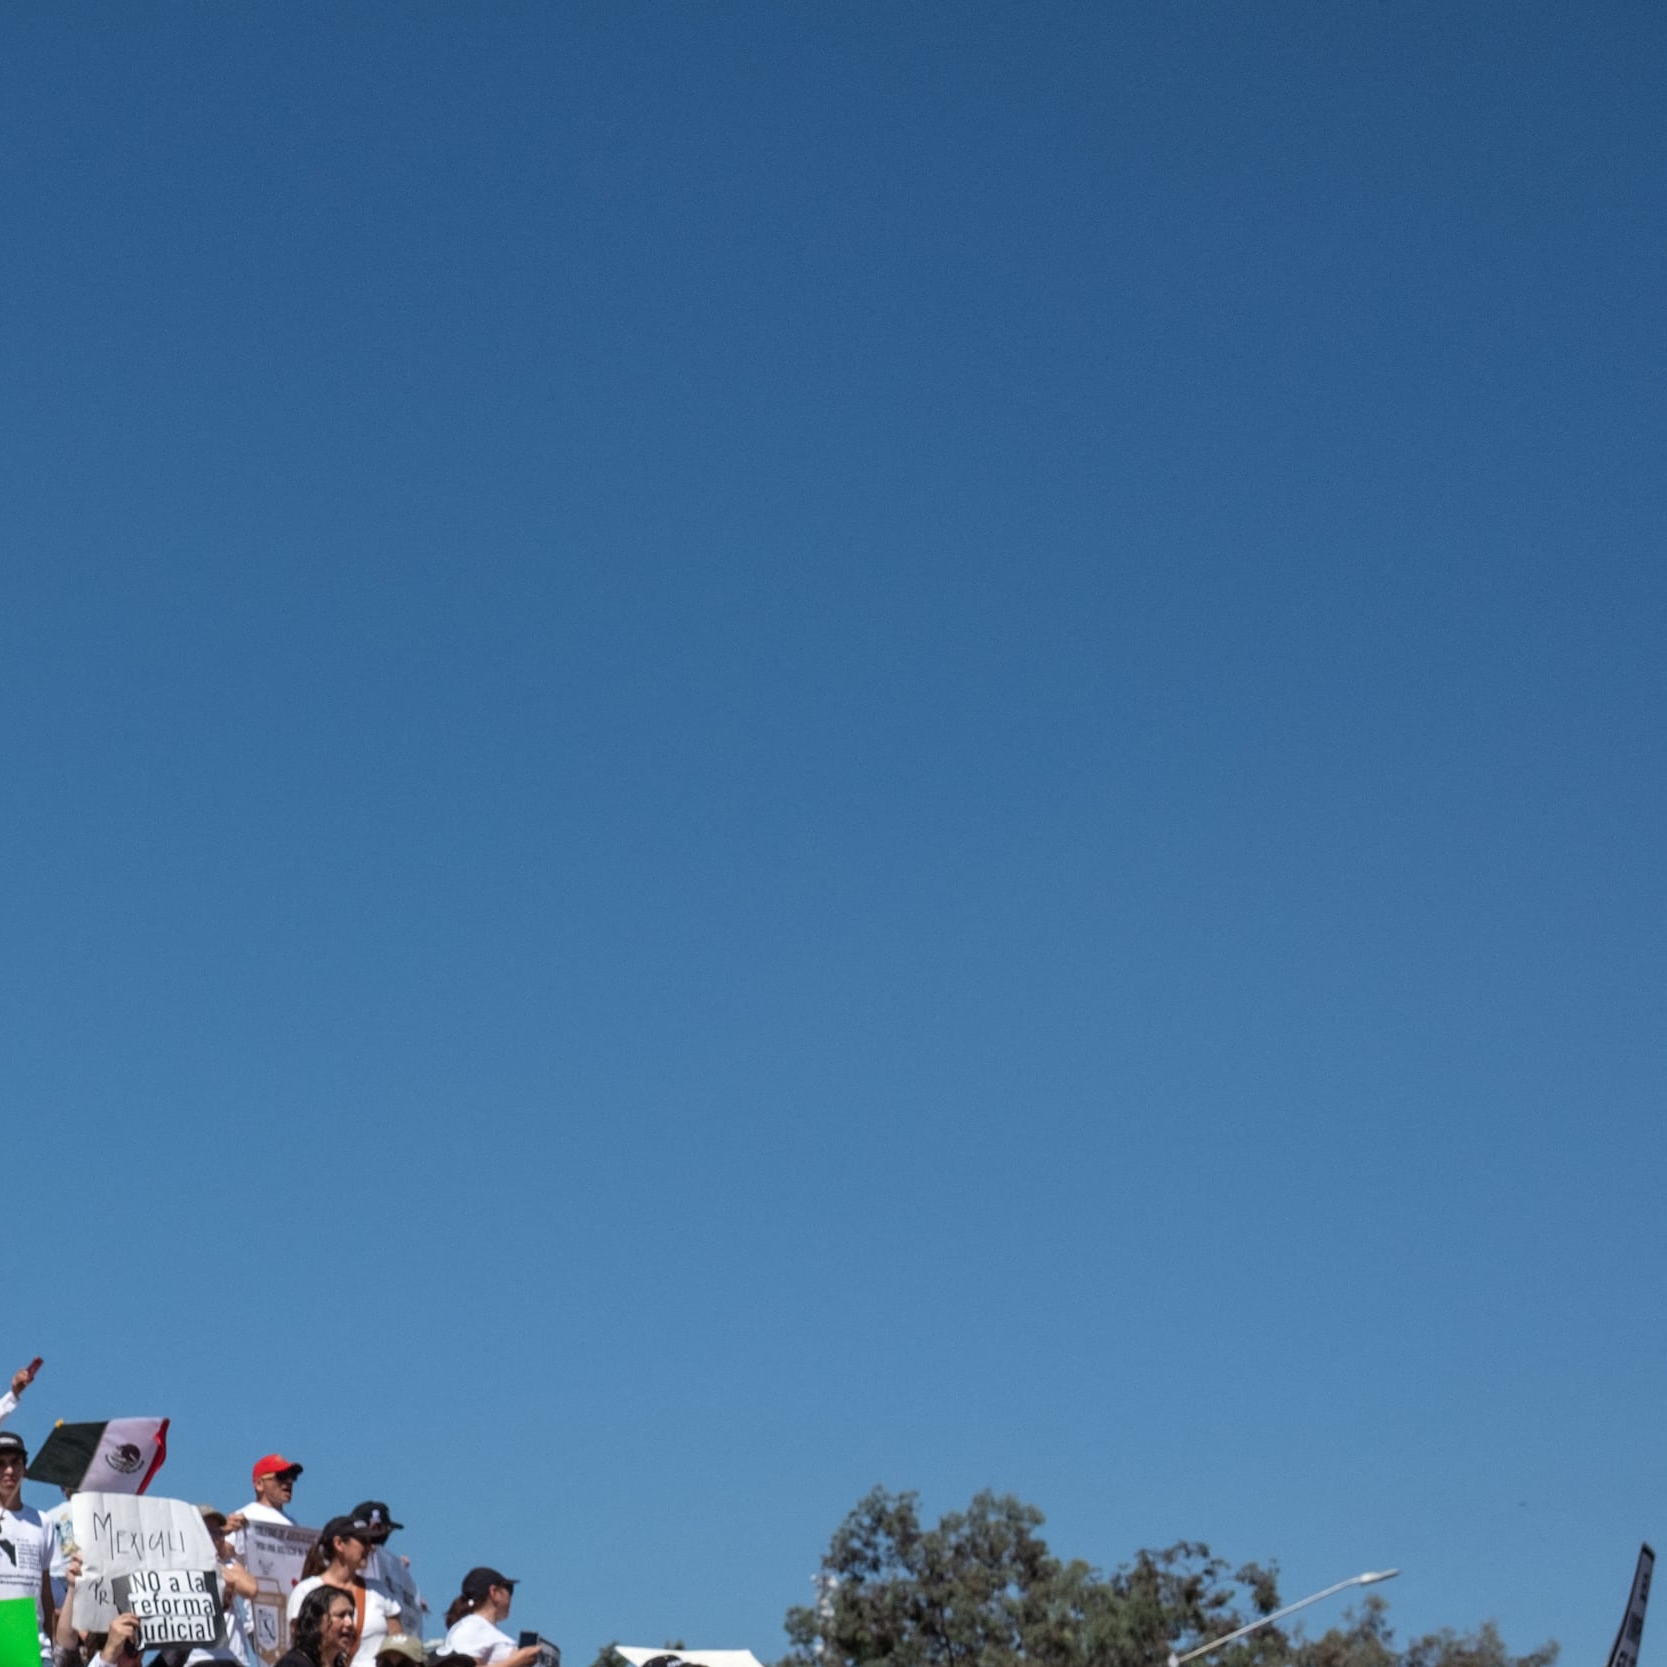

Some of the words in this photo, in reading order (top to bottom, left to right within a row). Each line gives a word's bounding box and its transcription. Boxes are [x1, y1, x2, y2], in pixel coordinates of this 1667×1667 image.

[131, 1571, 161, 1595] NO
[168, 1576, 181, 1593] a
[187, 1571, 207, 1593] la
[131, 1593, 216, 1617] reforma
